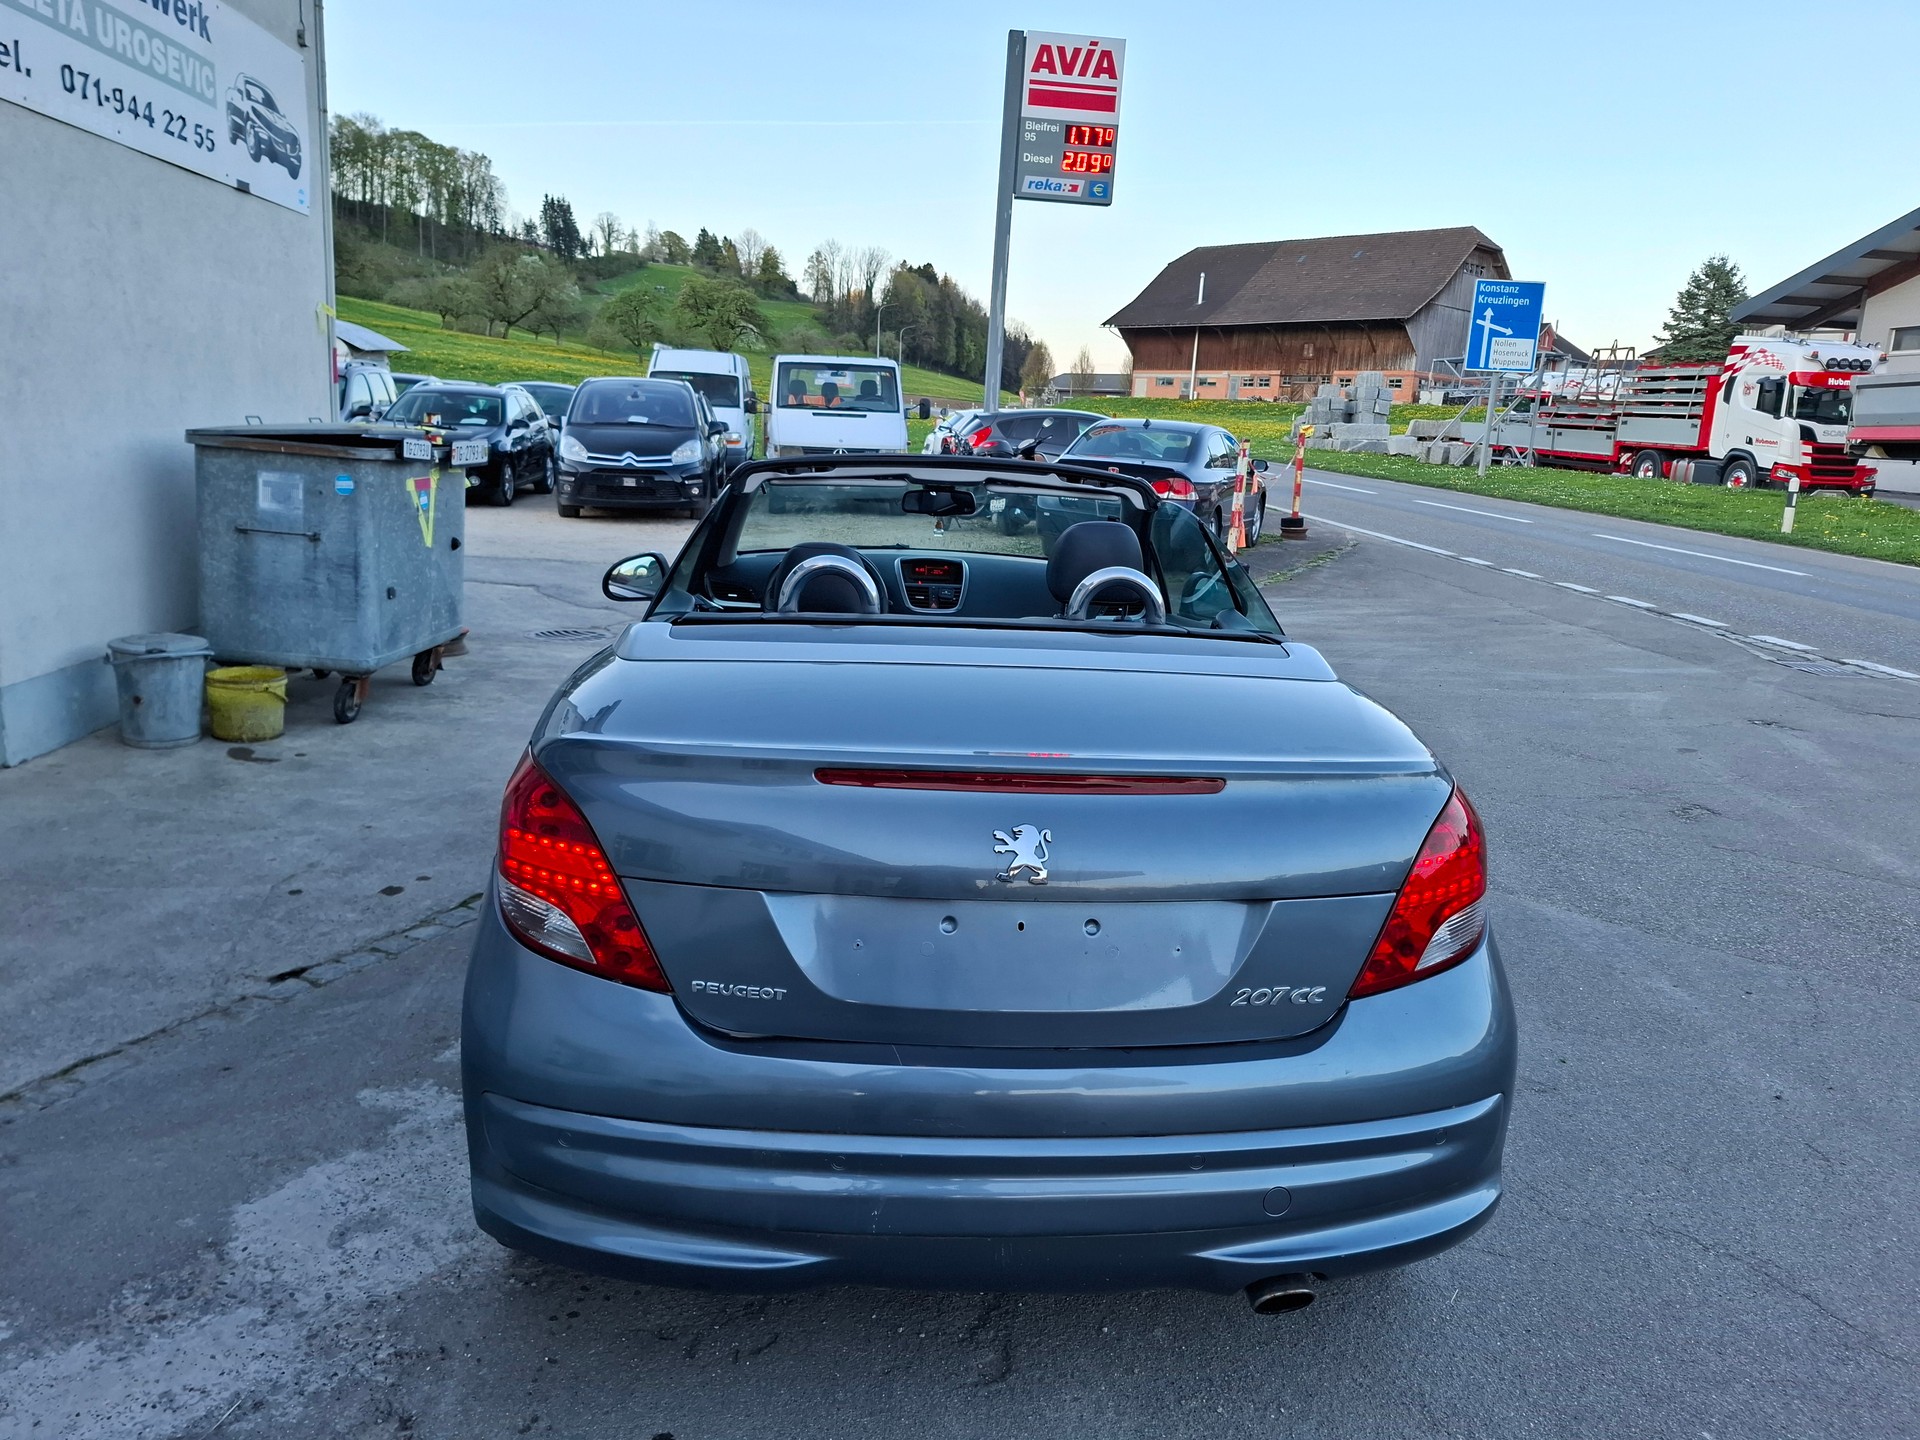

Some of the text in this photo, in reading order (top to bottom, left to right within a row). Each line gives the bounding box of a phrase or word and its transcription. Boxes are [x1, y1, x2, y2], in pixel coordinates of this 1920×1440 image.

[95, 7, 215, 100] UROSEVIC
[61, 64, 155, 128] 071-944
[162, 109, 188, 142] 22
[194, 123, 216, 152] 55
[1025, 121, 1060, 133] Bleifrei
[1024, 132, 1037, 142] 95
[1023, 153, 1053, 164] Diesel
[1479, 283, 1520, 294] Konstanz
[1478, 294, 1530, 308] Kreuzlingen
[1494, 339, 1517, 348] Nollen
[1493, 349, 1529, 357] Hosenruck
[1492, 358, 1529, 367] Wuppenau
[691, 980, 787, 1001] PEUGEOT
